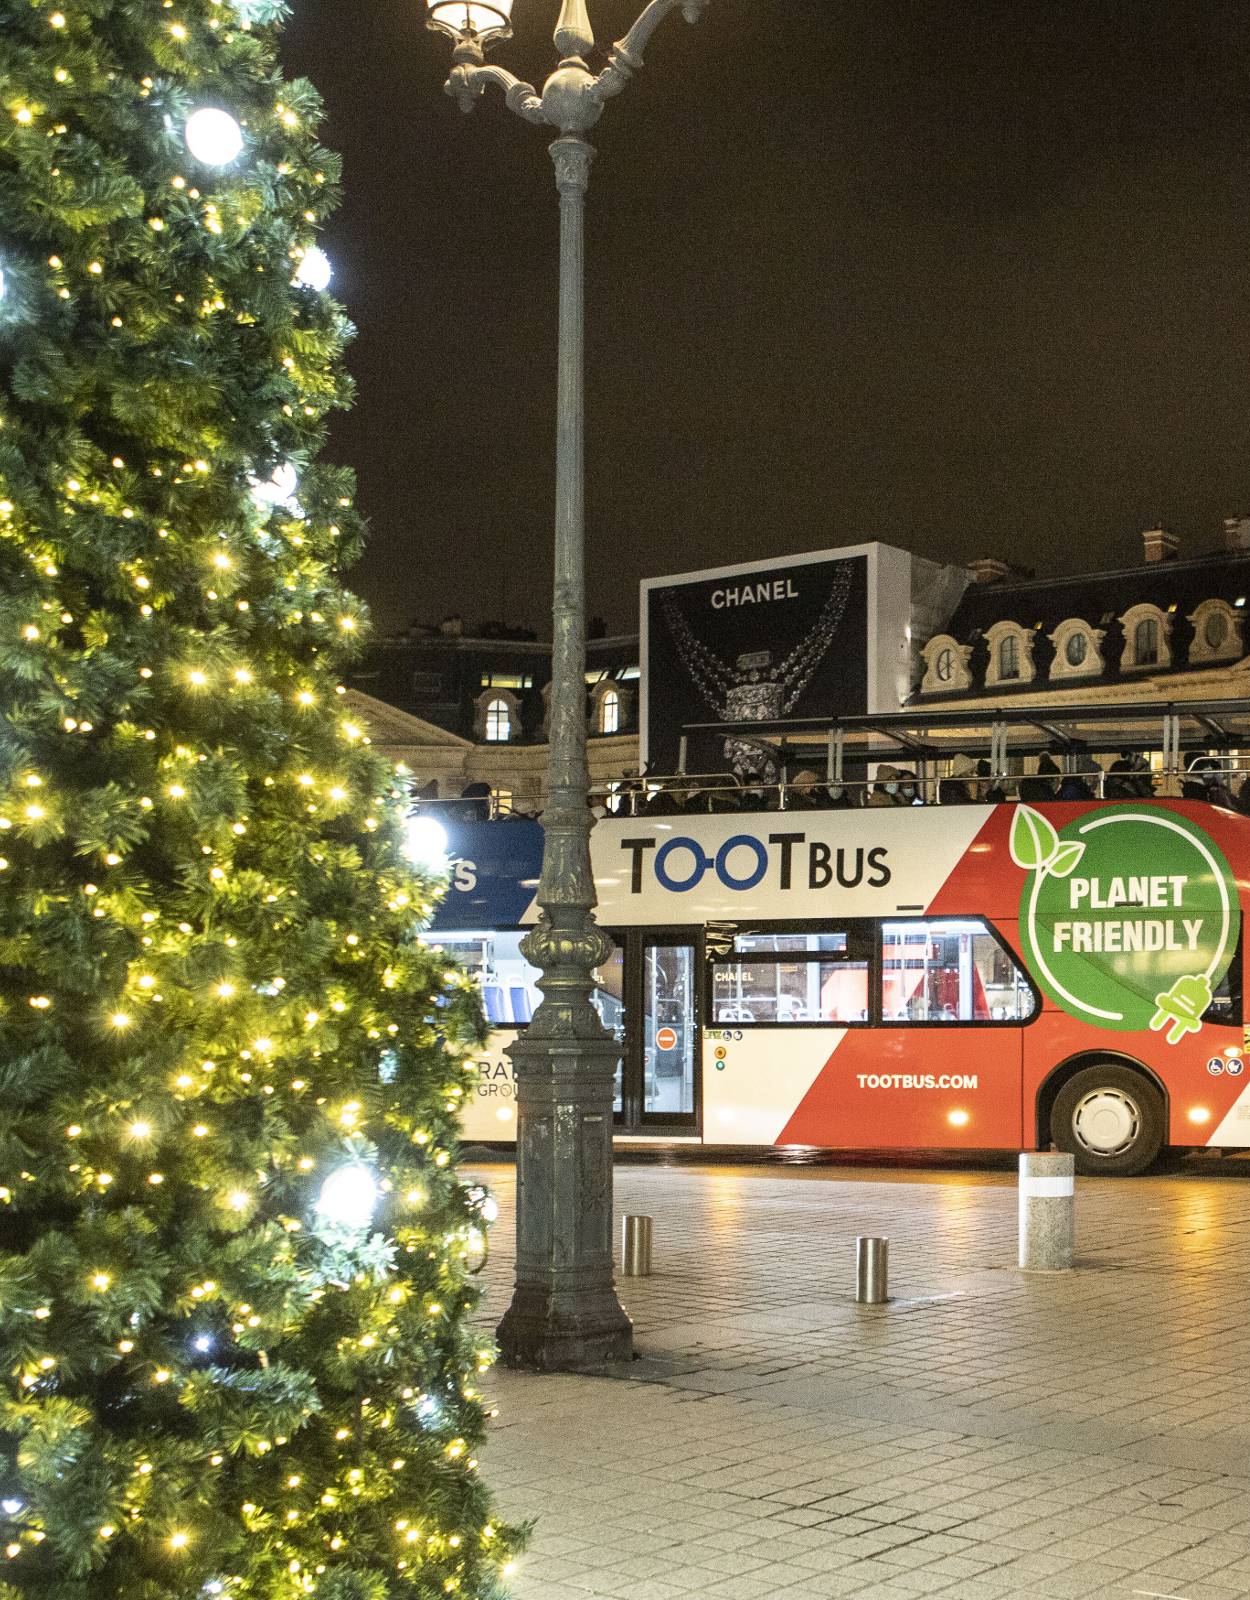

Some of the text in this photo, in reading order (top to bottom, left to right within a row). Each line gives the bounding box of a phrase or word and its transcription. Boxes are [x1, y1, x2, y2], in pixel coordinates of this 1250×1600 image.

[711, 579, 799, 609] CHANEL
[1069, 875, 1188, 909] PLANET
[1053, 919, 1204, 953] FRIENDLY
[856, 1074, 978, 1089] TOOTBUS.COM
